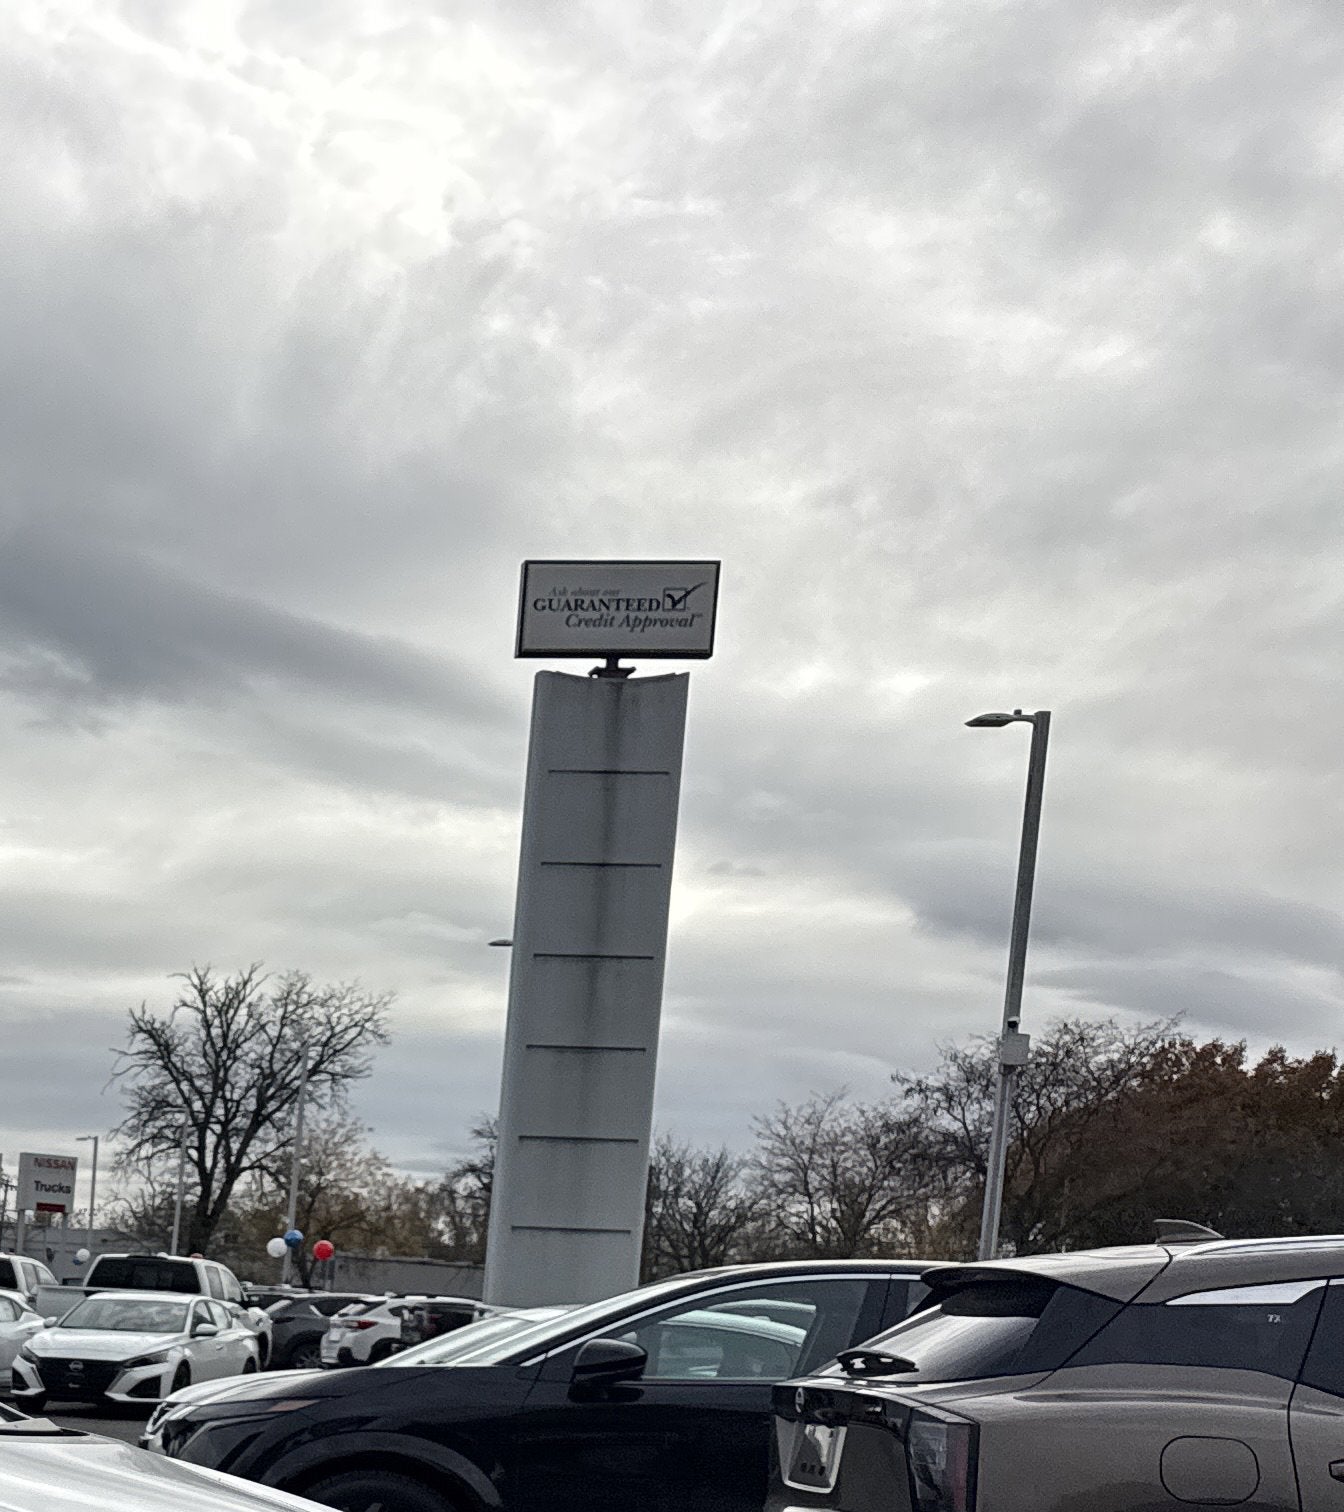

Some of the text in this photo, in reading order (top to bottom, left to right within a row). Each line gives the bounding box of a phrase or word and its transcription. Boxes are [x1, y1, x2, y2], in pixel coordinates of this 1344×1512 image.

[533, 597, 661, 613] GUARANTEED
[565, 613, 696, 633] Credit Approval
[34, 1157, 75, 1171] NISSAN
[34, 1180, 72, 1194] Trucks
